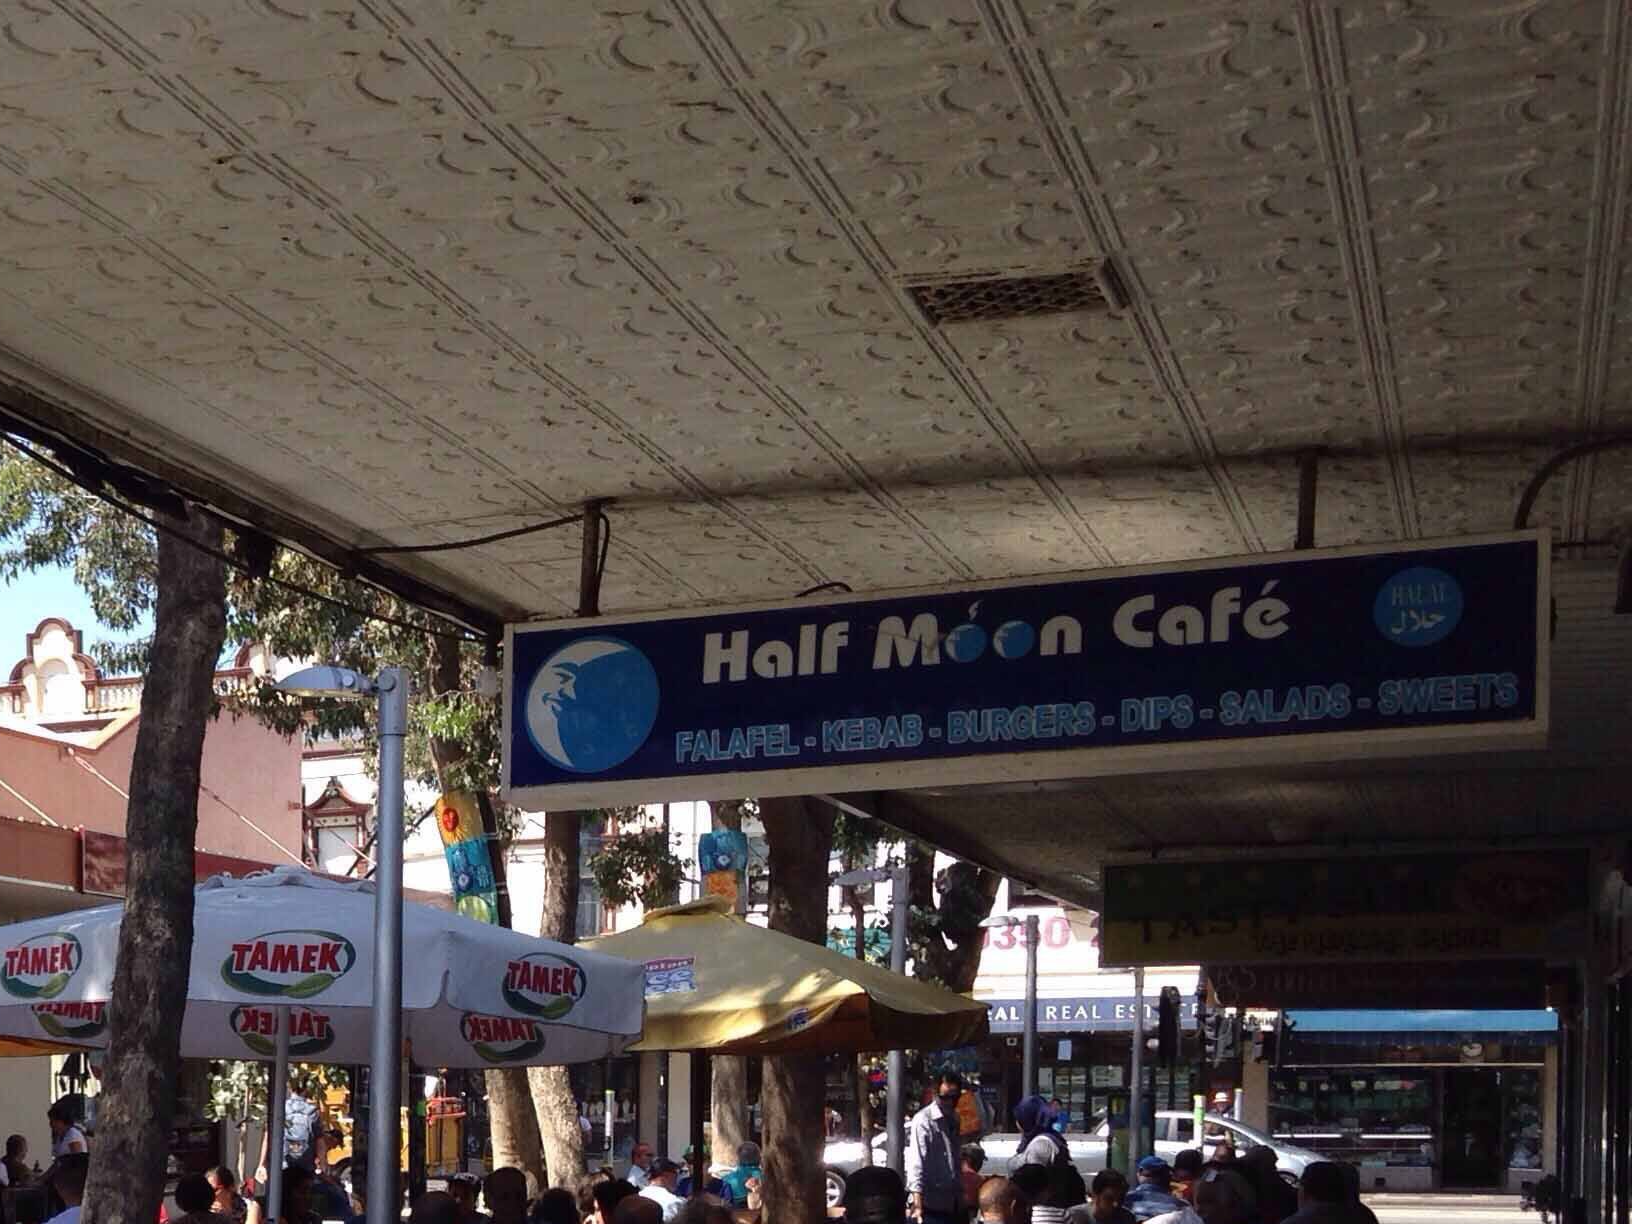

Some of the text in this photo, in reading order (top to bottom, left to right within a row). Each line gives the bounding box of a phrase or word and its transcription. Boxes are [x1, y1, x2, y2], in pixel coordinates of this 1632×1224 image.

[702, 621, 850, 684] Half
[1112, 580, 1291, 649] Café
[675, 723, 800, 763] FALAFEL
[822, 714, 923, 752] KEBAB
[946, 701, 1096, 745] BURGERS
[1120, 694, 1195, 732] DIPS
[1219, 683, 1352, 726] SALADS
[1378, 672, 1519, 716] SWEETS
[5, 943, 75, 977] TAMEK
[231, 941, 343, 973] TAMEK
[507, 960, 579, 995] TAMEK
[1045, 1004, 1101, 1020] REAL
